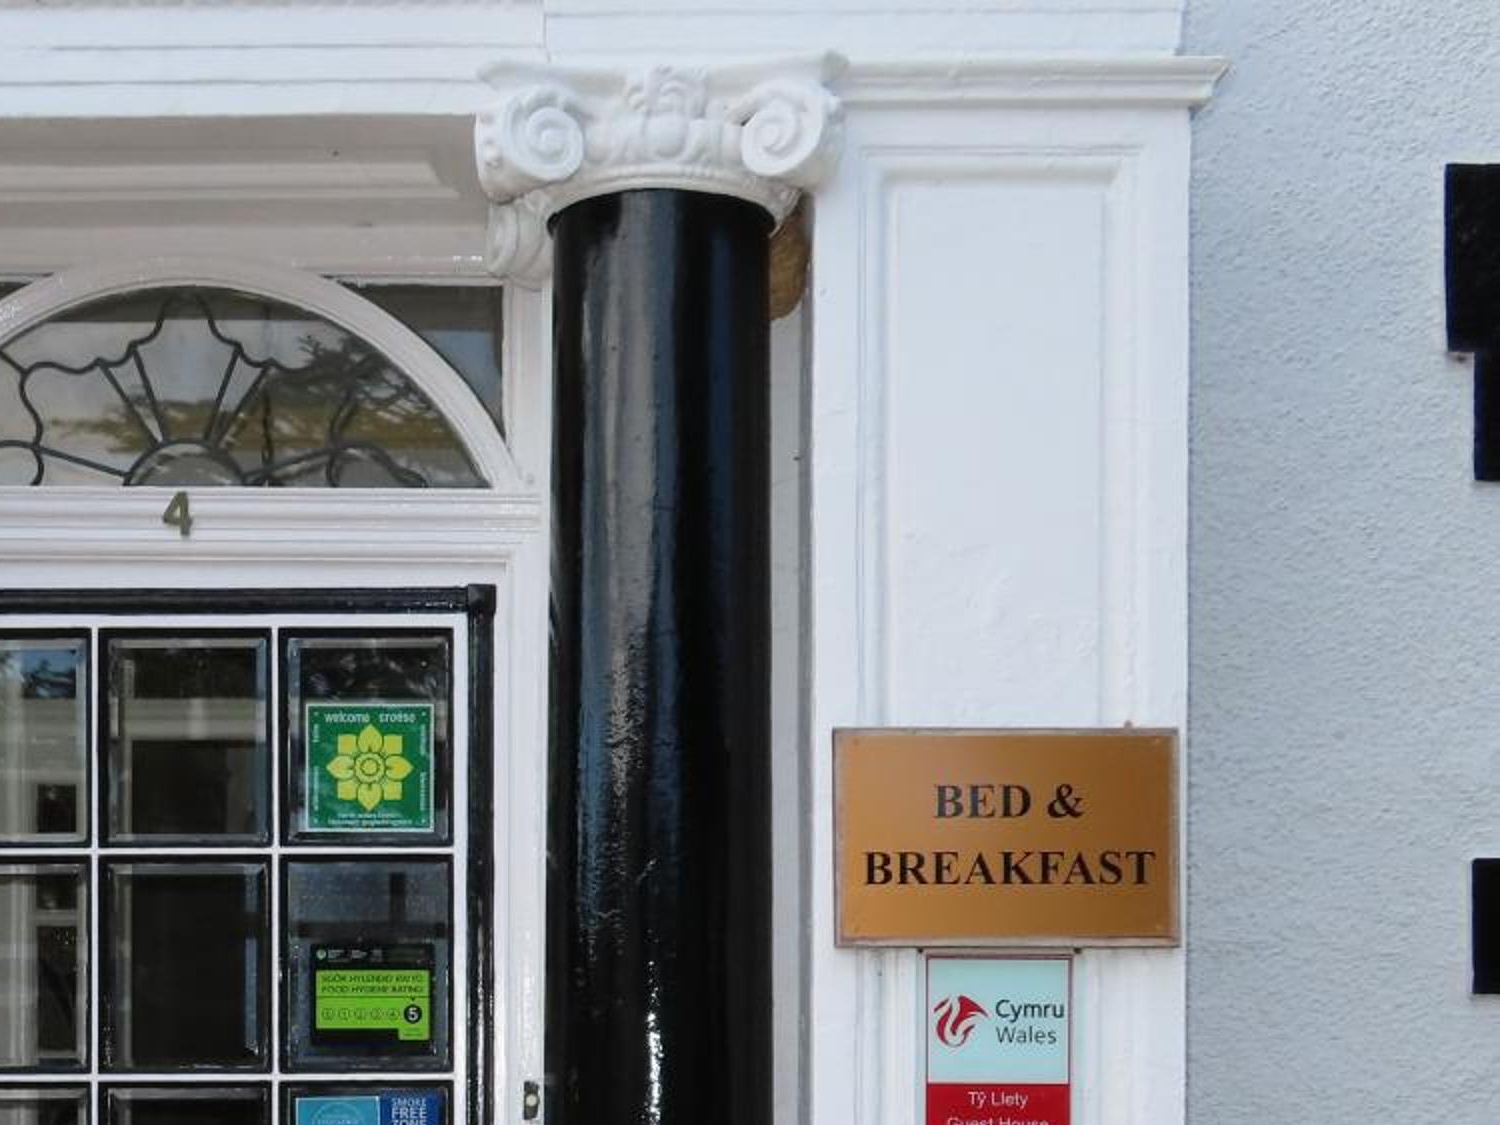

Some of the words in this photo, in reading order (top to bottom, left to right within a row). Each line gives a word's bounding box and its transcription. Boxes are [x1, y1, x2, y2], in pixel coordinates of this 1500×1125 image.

[162, 491, 194, 536] 4
[324, 710, 371, 723] welcome
[379, 712, 417, 723] croeso
[933, 783, 1032, 819] BED
[1046, 783, 1084, 819] &
[863, 850, 1156, 886] BREAKFAST
[407, 1007, 419, 1021] 5
[994, 999, 1066, 1024] Cymru
[995, 1026, 1058, 1045] Wales
[991, 1091, 1029, 1109] Llety
[391, 1107, 428, 1119] FREE
